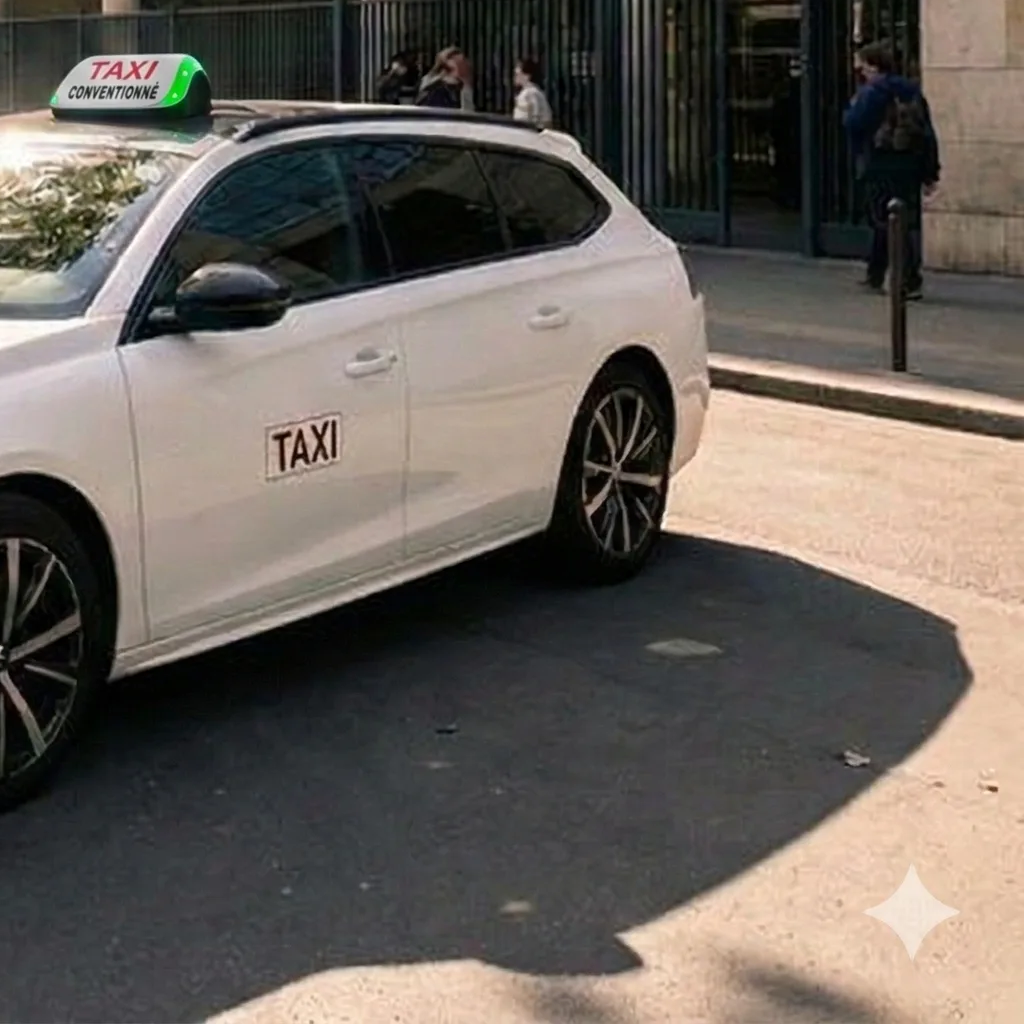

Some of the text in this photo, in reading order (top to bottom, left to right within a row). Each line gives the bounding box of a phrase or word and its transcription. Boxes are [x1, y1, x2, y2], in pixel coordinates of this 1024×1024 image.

[90, 60, 159, 80] TAXI
[68, 82, 159, 100] CONVENTIONNÉ
[272, 419, 337, 472] TAXI
